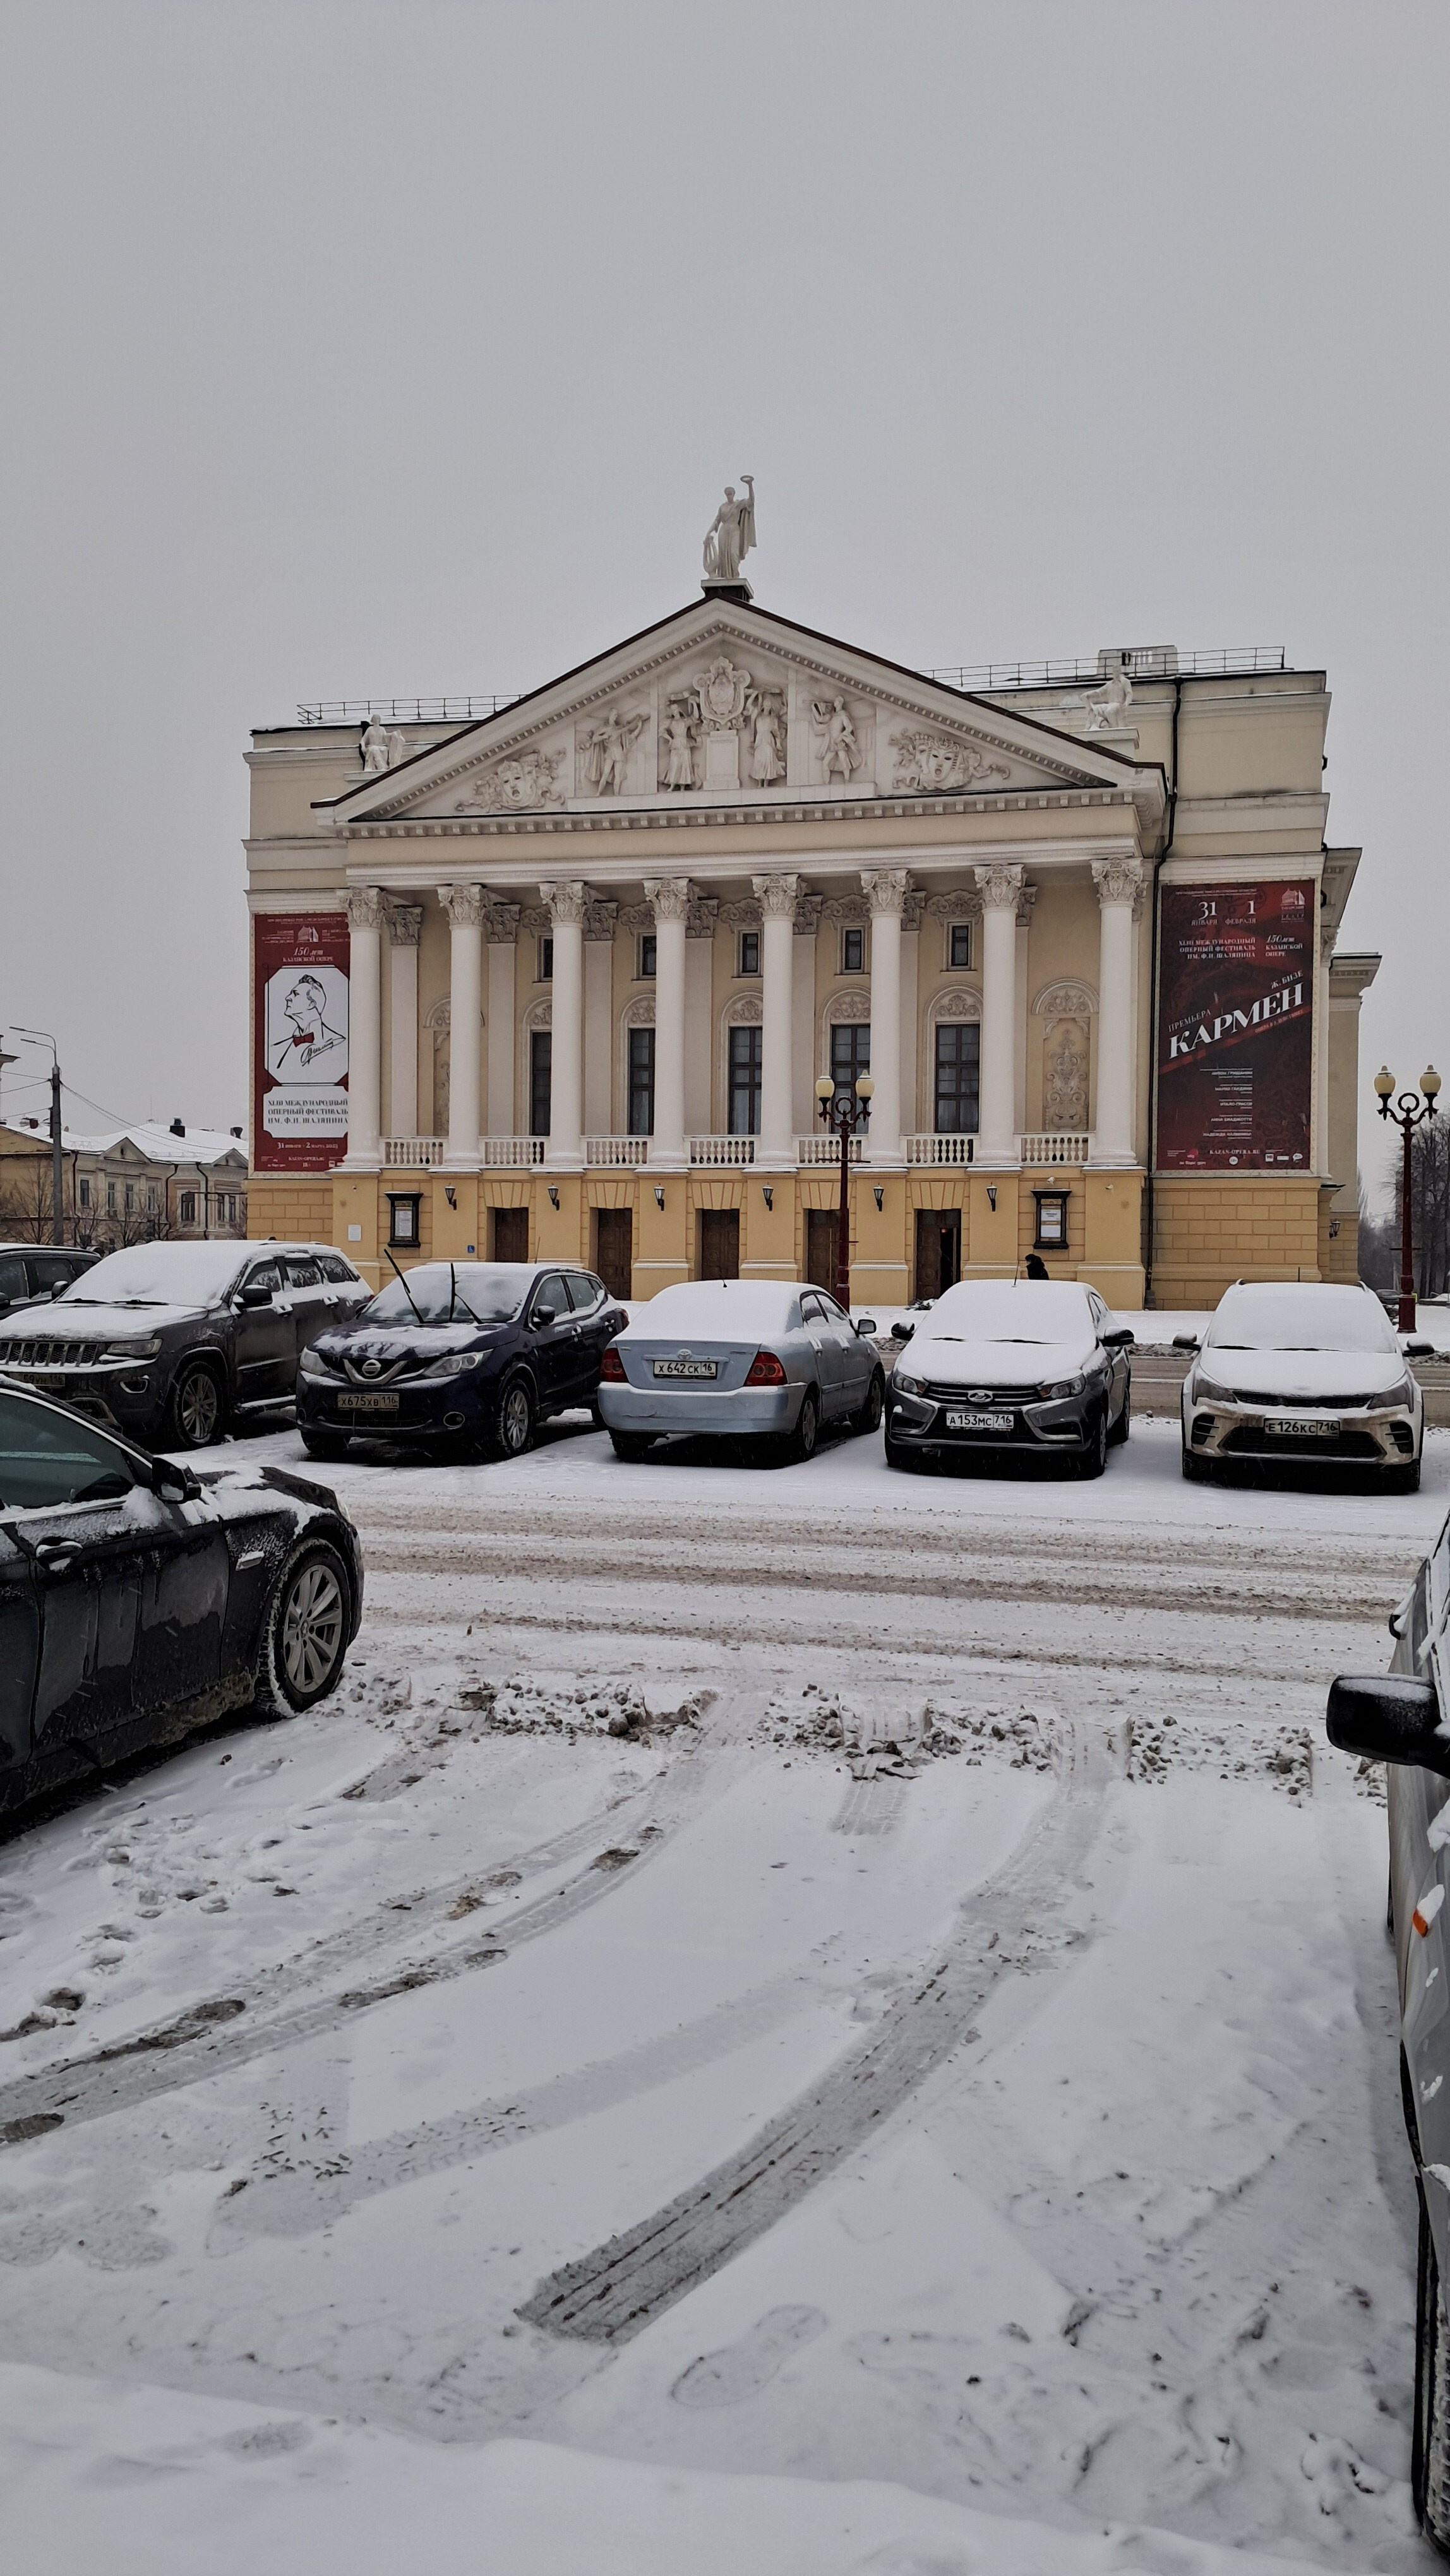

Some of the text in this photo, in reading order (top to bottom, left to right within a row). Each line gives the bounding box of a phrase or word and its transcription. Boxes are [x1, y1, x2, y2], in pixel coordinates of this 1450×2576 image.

[1198, 900, 1218, 919] 31
[1247, 900, 1256, 915] 1
[1266, 934, 1282, 943] 150
[293, 947, 309, 956] 150
[1282, 970, 1303, 984] БИЗЕ
[1168, 1008, 1211, 1032] ПРЕМЬЕРА
[1169, 982, 1304, 1059] КАРМЕН
[702, 1363, 712, 1371] 16
[342, 1396, 379, 1407] Х675ХВ
[949, 1414, 1012, 1426] А153МС 716
[1268, 1421, 1336, 1433] Е126КС 716
